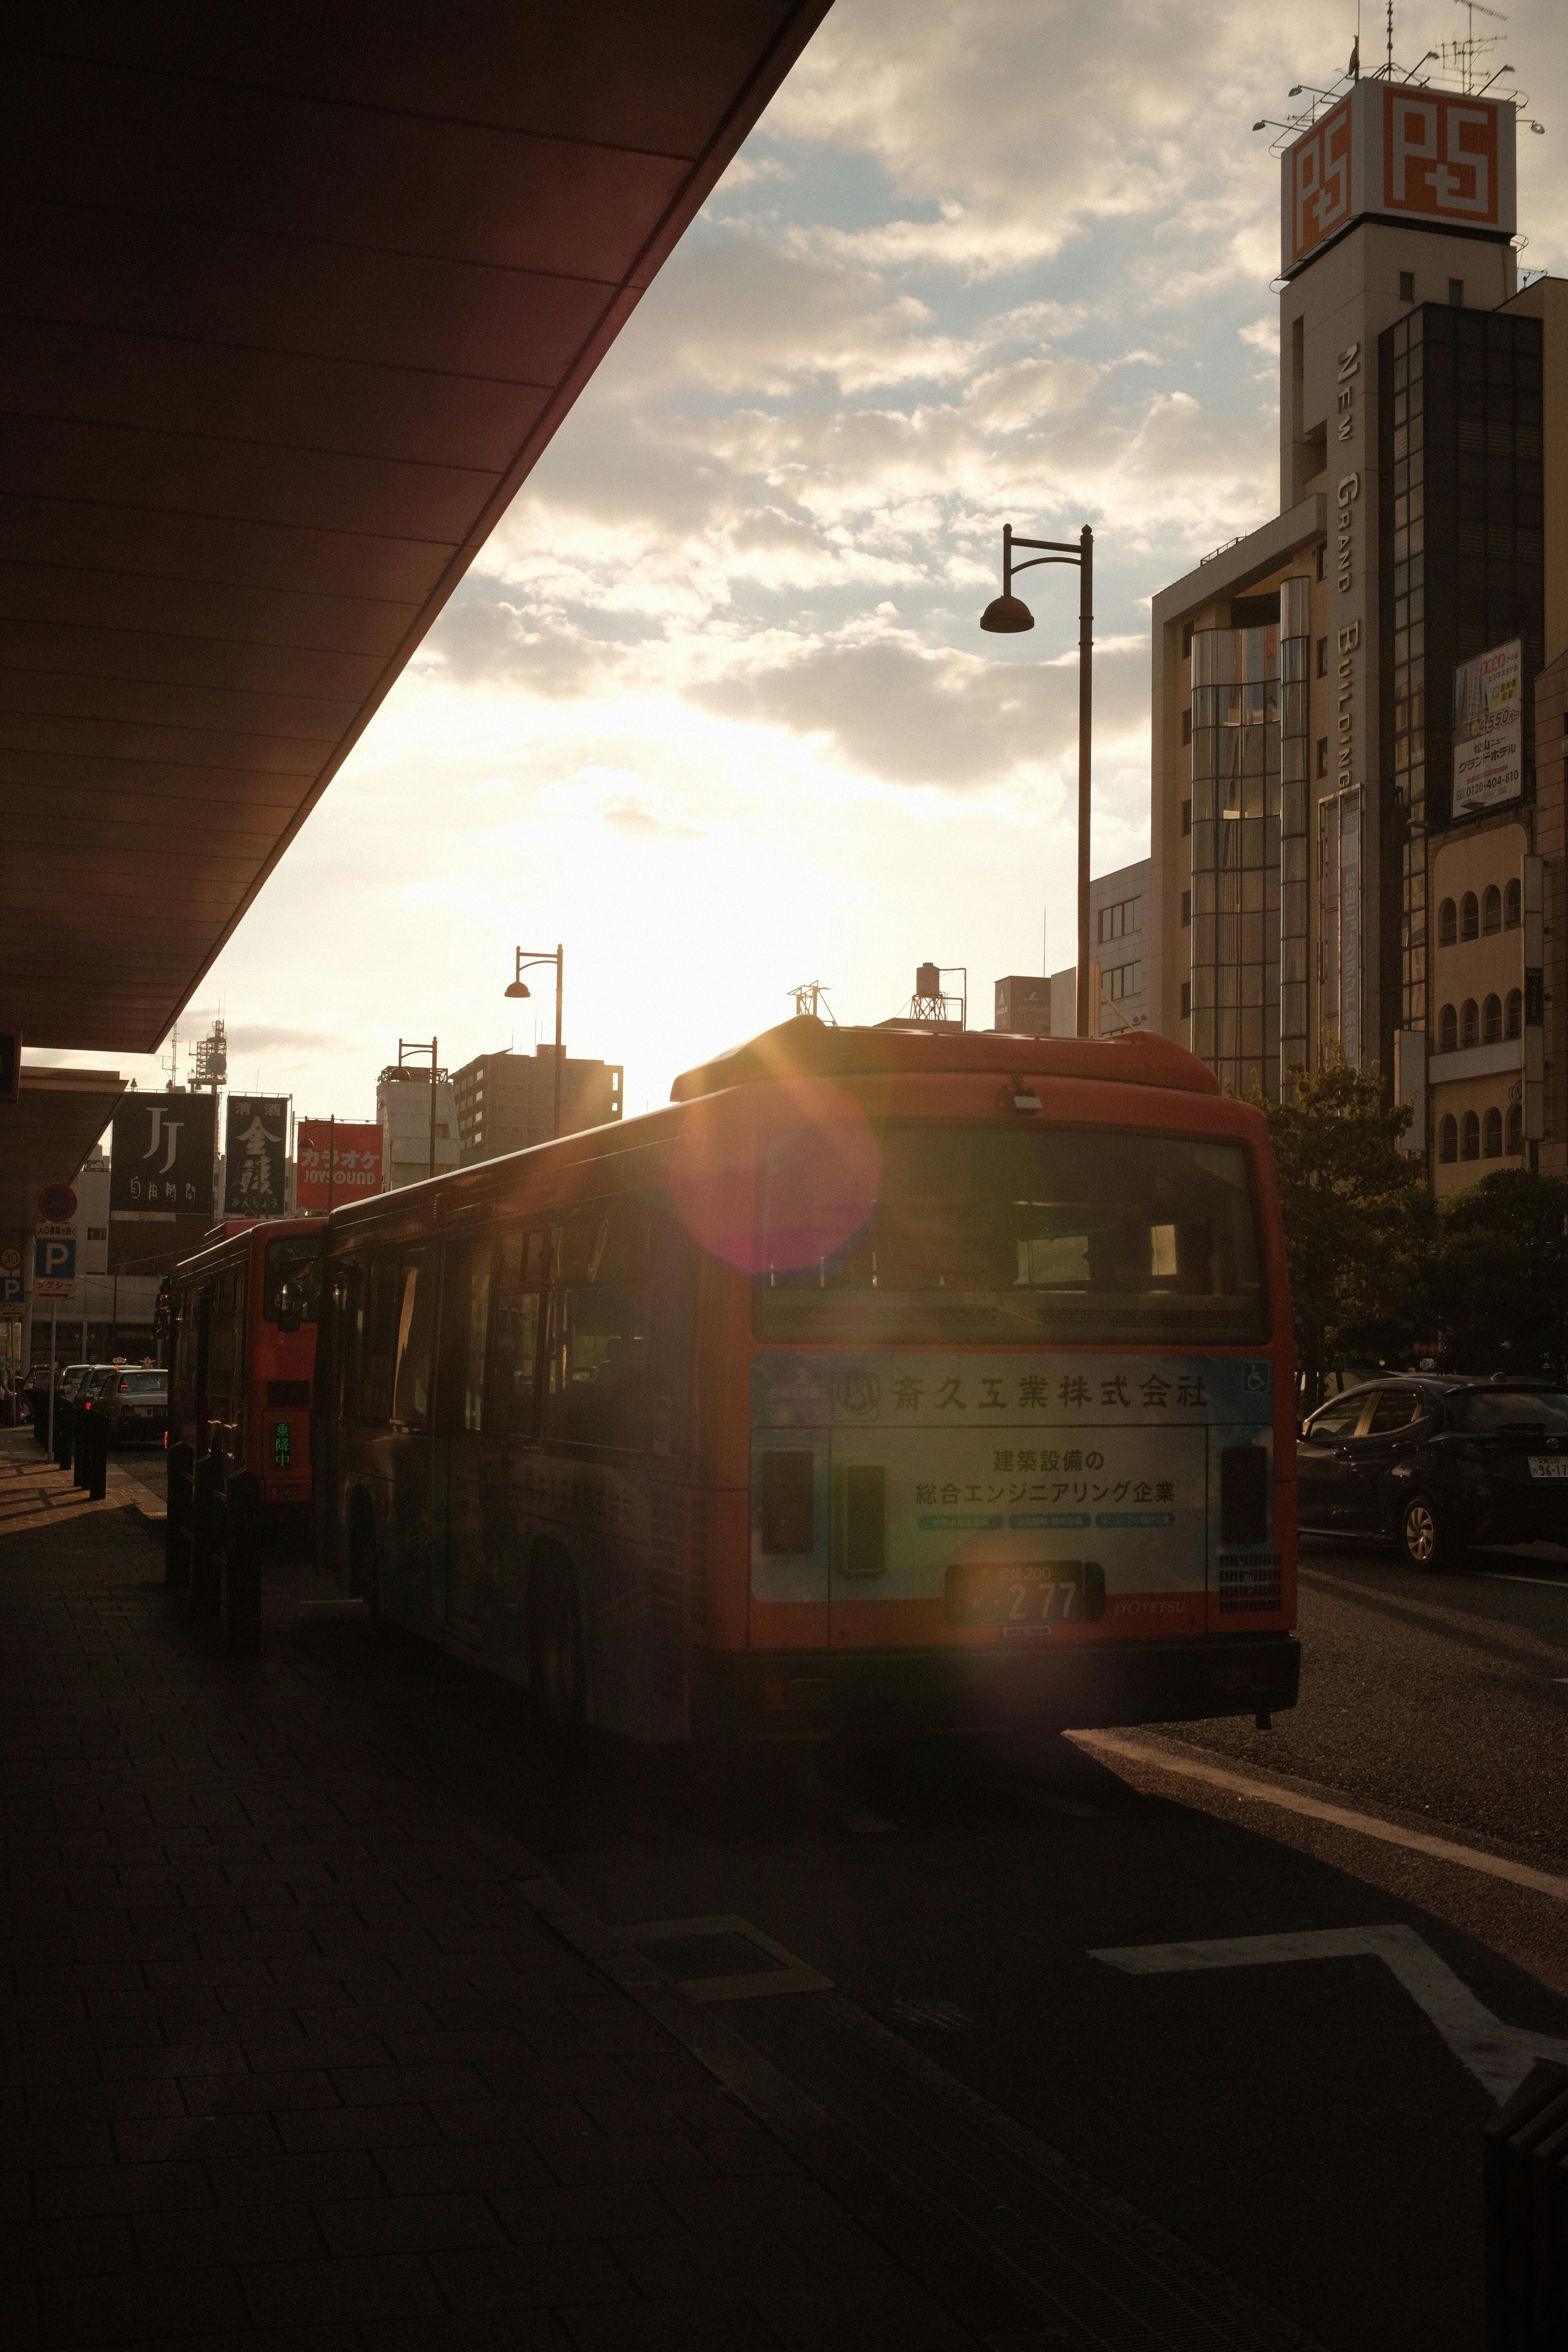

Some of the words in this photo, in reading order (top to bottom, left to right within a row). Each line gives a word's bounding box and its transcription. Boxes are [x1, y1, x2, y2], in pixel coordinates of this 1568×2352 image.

[1459, 744, 1516, 773] グランドホテル
[1466, 769, 1519, 797] 0120-404-810
[235, 1102, 281, 1116] 清酒
[301, 1148, 380, 1170] カラオケ
[303, 1169, 376, 1185] JOYSOUND
[38, 1227, 76, 1235] 人の乗降を除く
[4, 1252, 18, 1264] 30
[46, 1242, 68, 1275] P
[5, 1279, 20, 1300] P
[37, 1280, 72, 1289] タクシー
[275, 1423, 290, 1467] 乗降中
[993, 1449, 1105, 1473] 建築設備の
[916, 1482, 1174, 1505] 総合エンジニアリング企業
[1113, 1600, 1186, 1615] IYOTETSU
